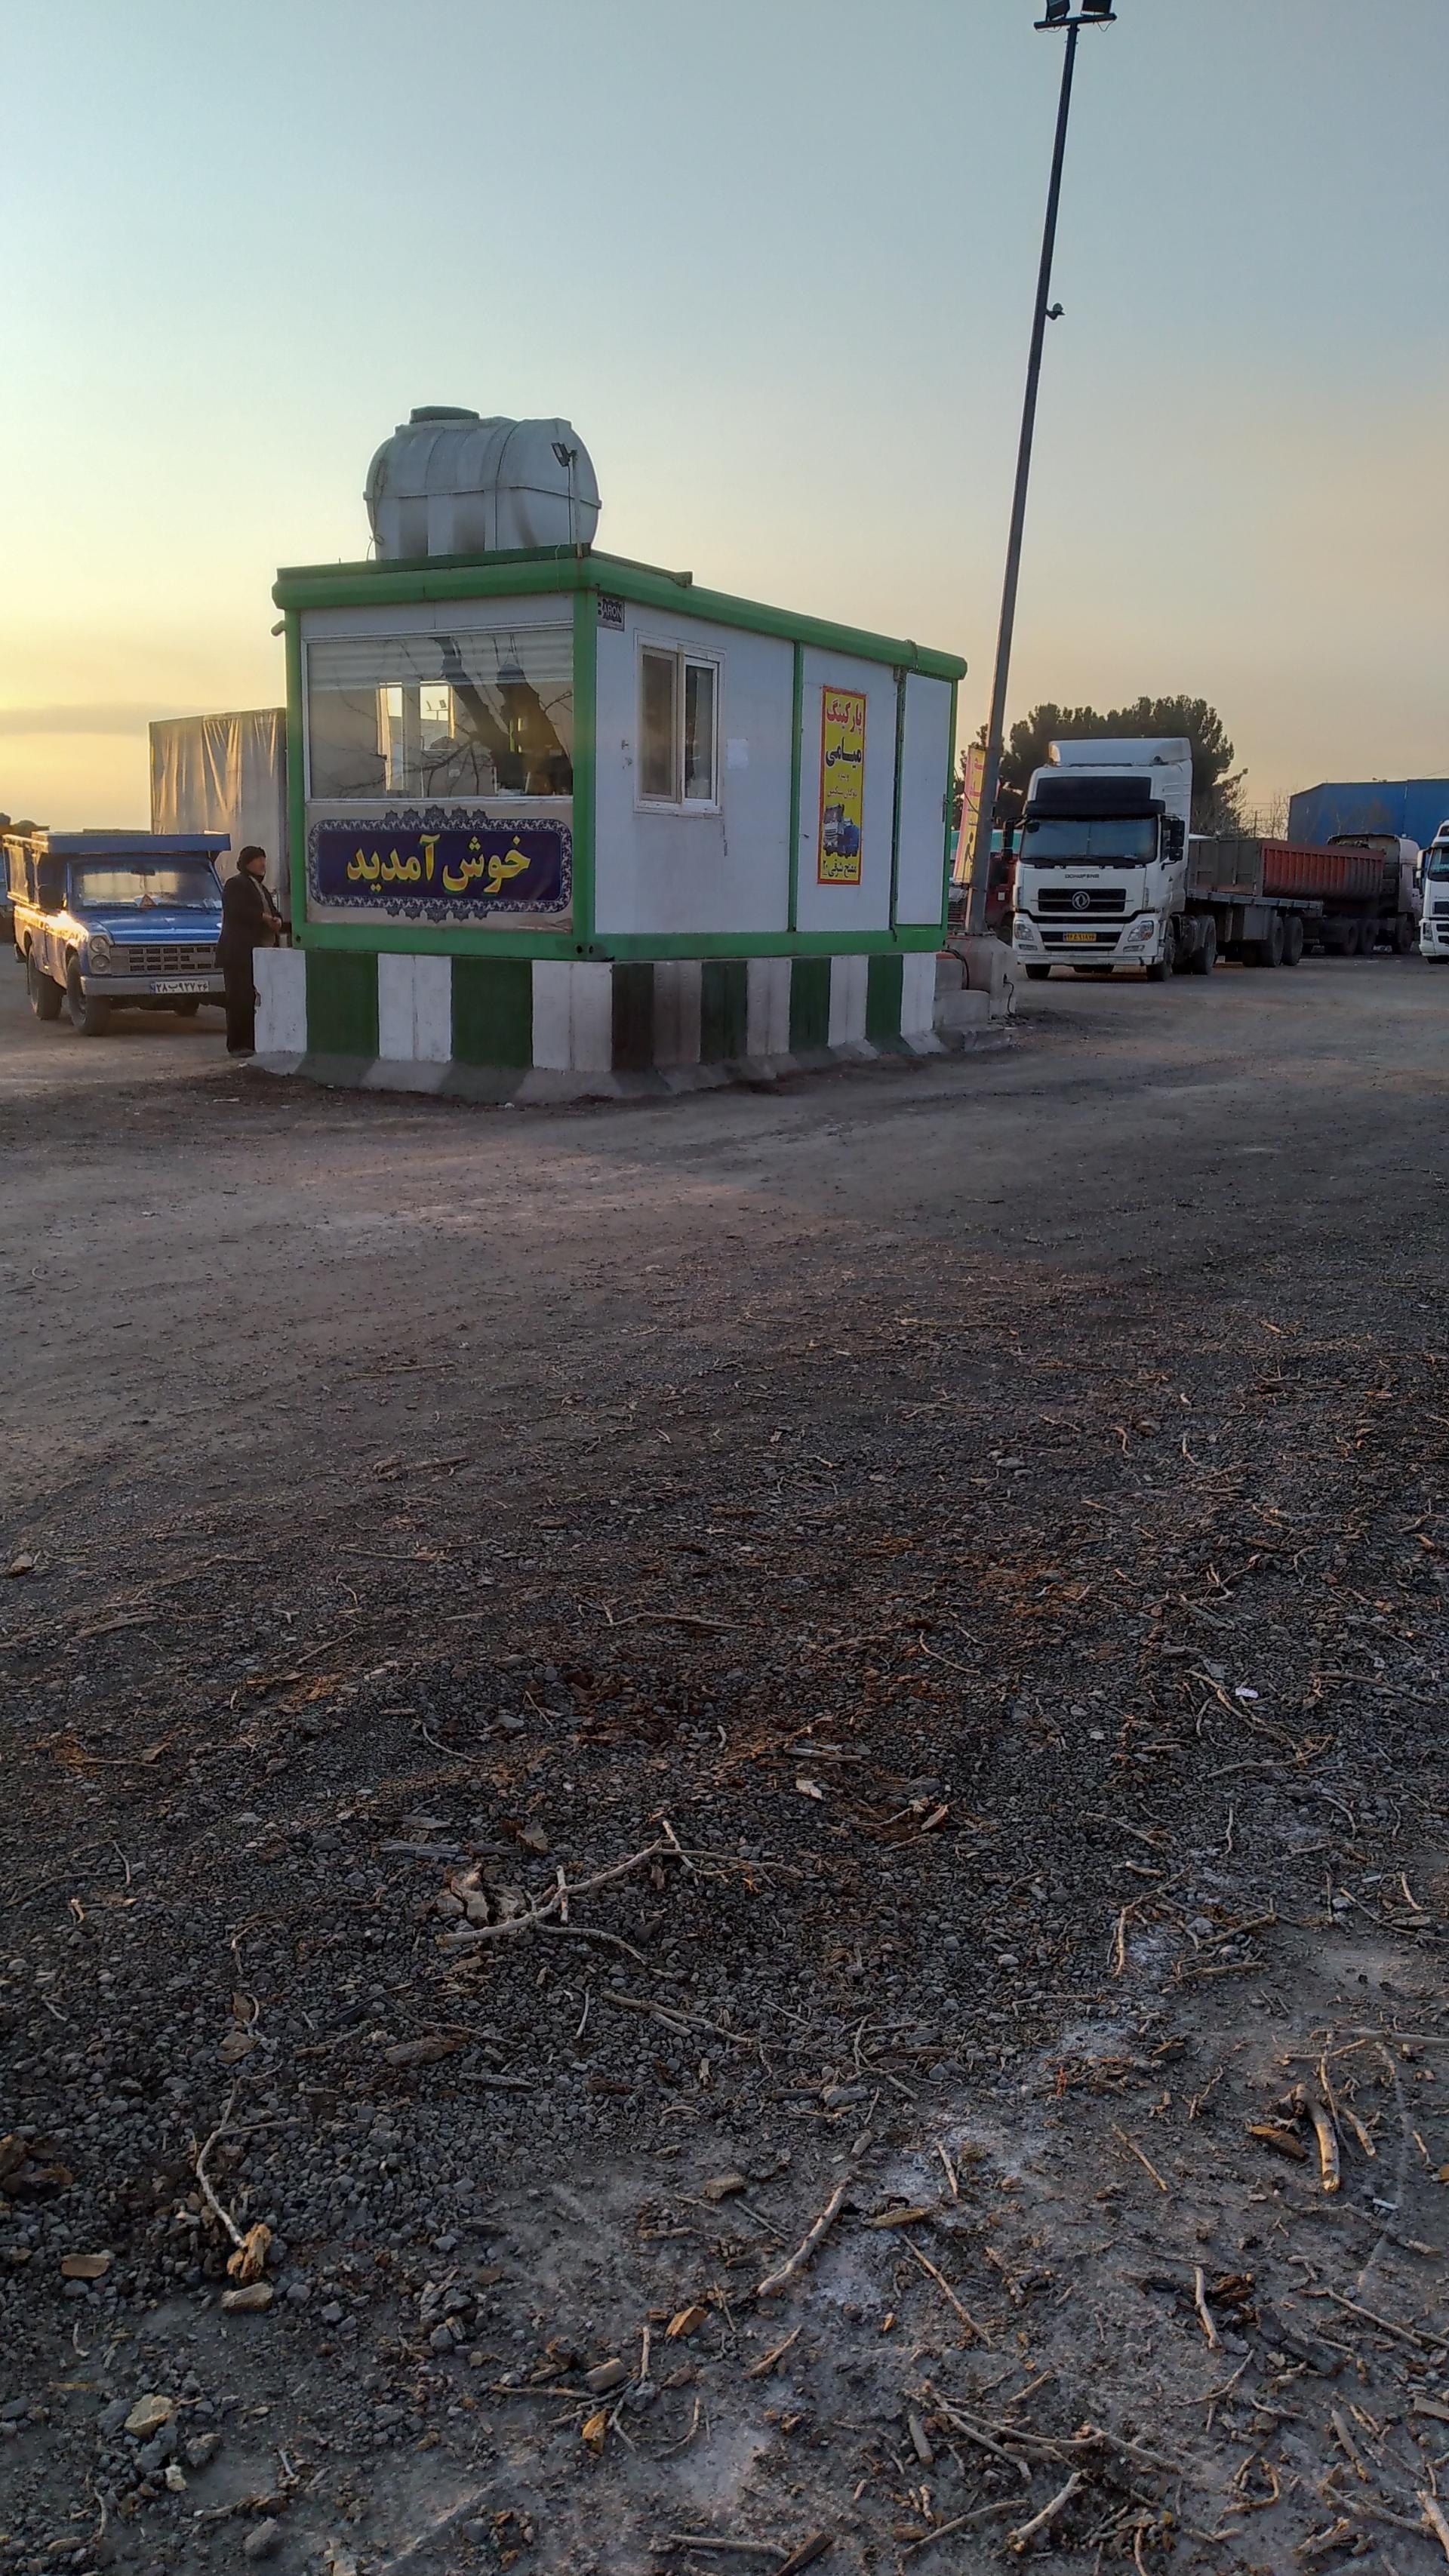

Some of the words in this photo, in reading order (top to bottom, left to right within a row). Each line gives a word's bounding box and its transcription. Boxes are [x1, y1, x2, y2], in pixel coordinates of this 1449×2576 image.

[597, 599, 622, 623] BARON
[827, 700, 862, 734] پارکینگ
[826, 737, 862, 768] میامی
[346, 834, 440, 892] آمدید
[442, 836, 531, 893] خوش
